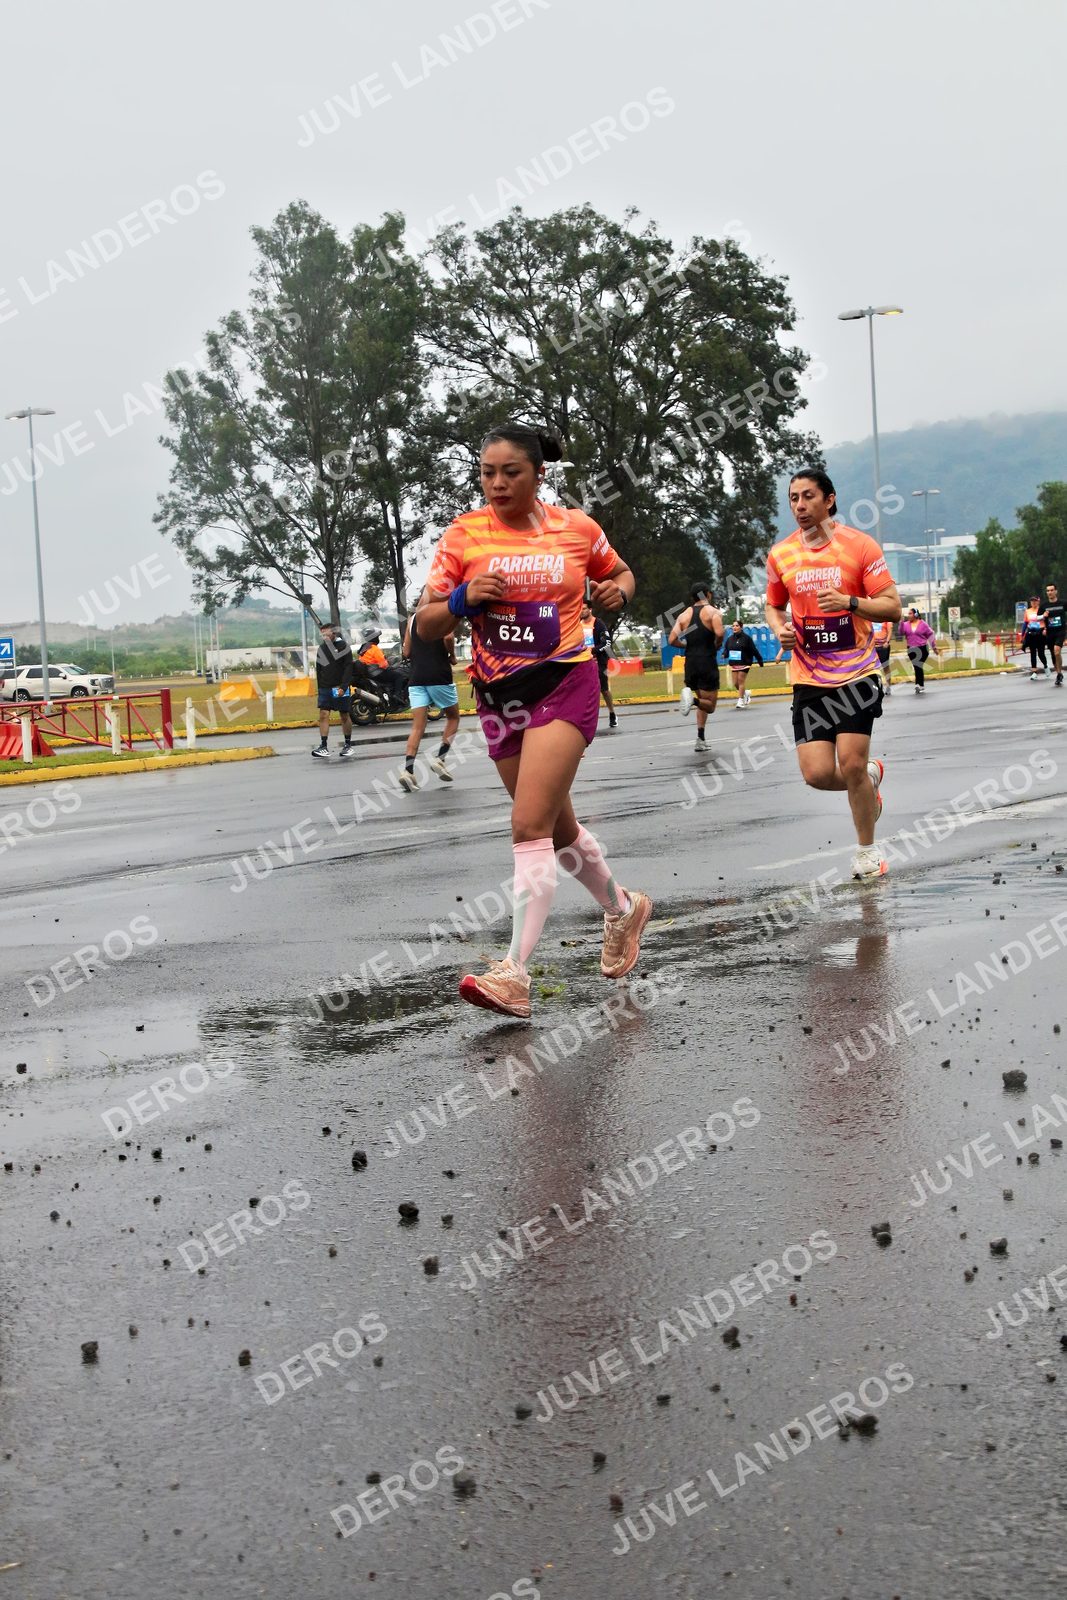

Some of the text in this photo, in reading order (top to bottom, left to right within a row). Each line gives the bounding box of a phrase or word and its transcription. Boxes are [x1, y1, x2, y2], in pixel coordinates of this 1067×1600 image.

[488, 555, 564, 573] CARRERA
[504, 574, 547, 586] MNILIFE
[796, 567, 842, 584] CARRERA
[796, 581, 832, 593] OMNILIFE
[499, 624, 535, 643] 624
[814, 632, 838, 643] 138
